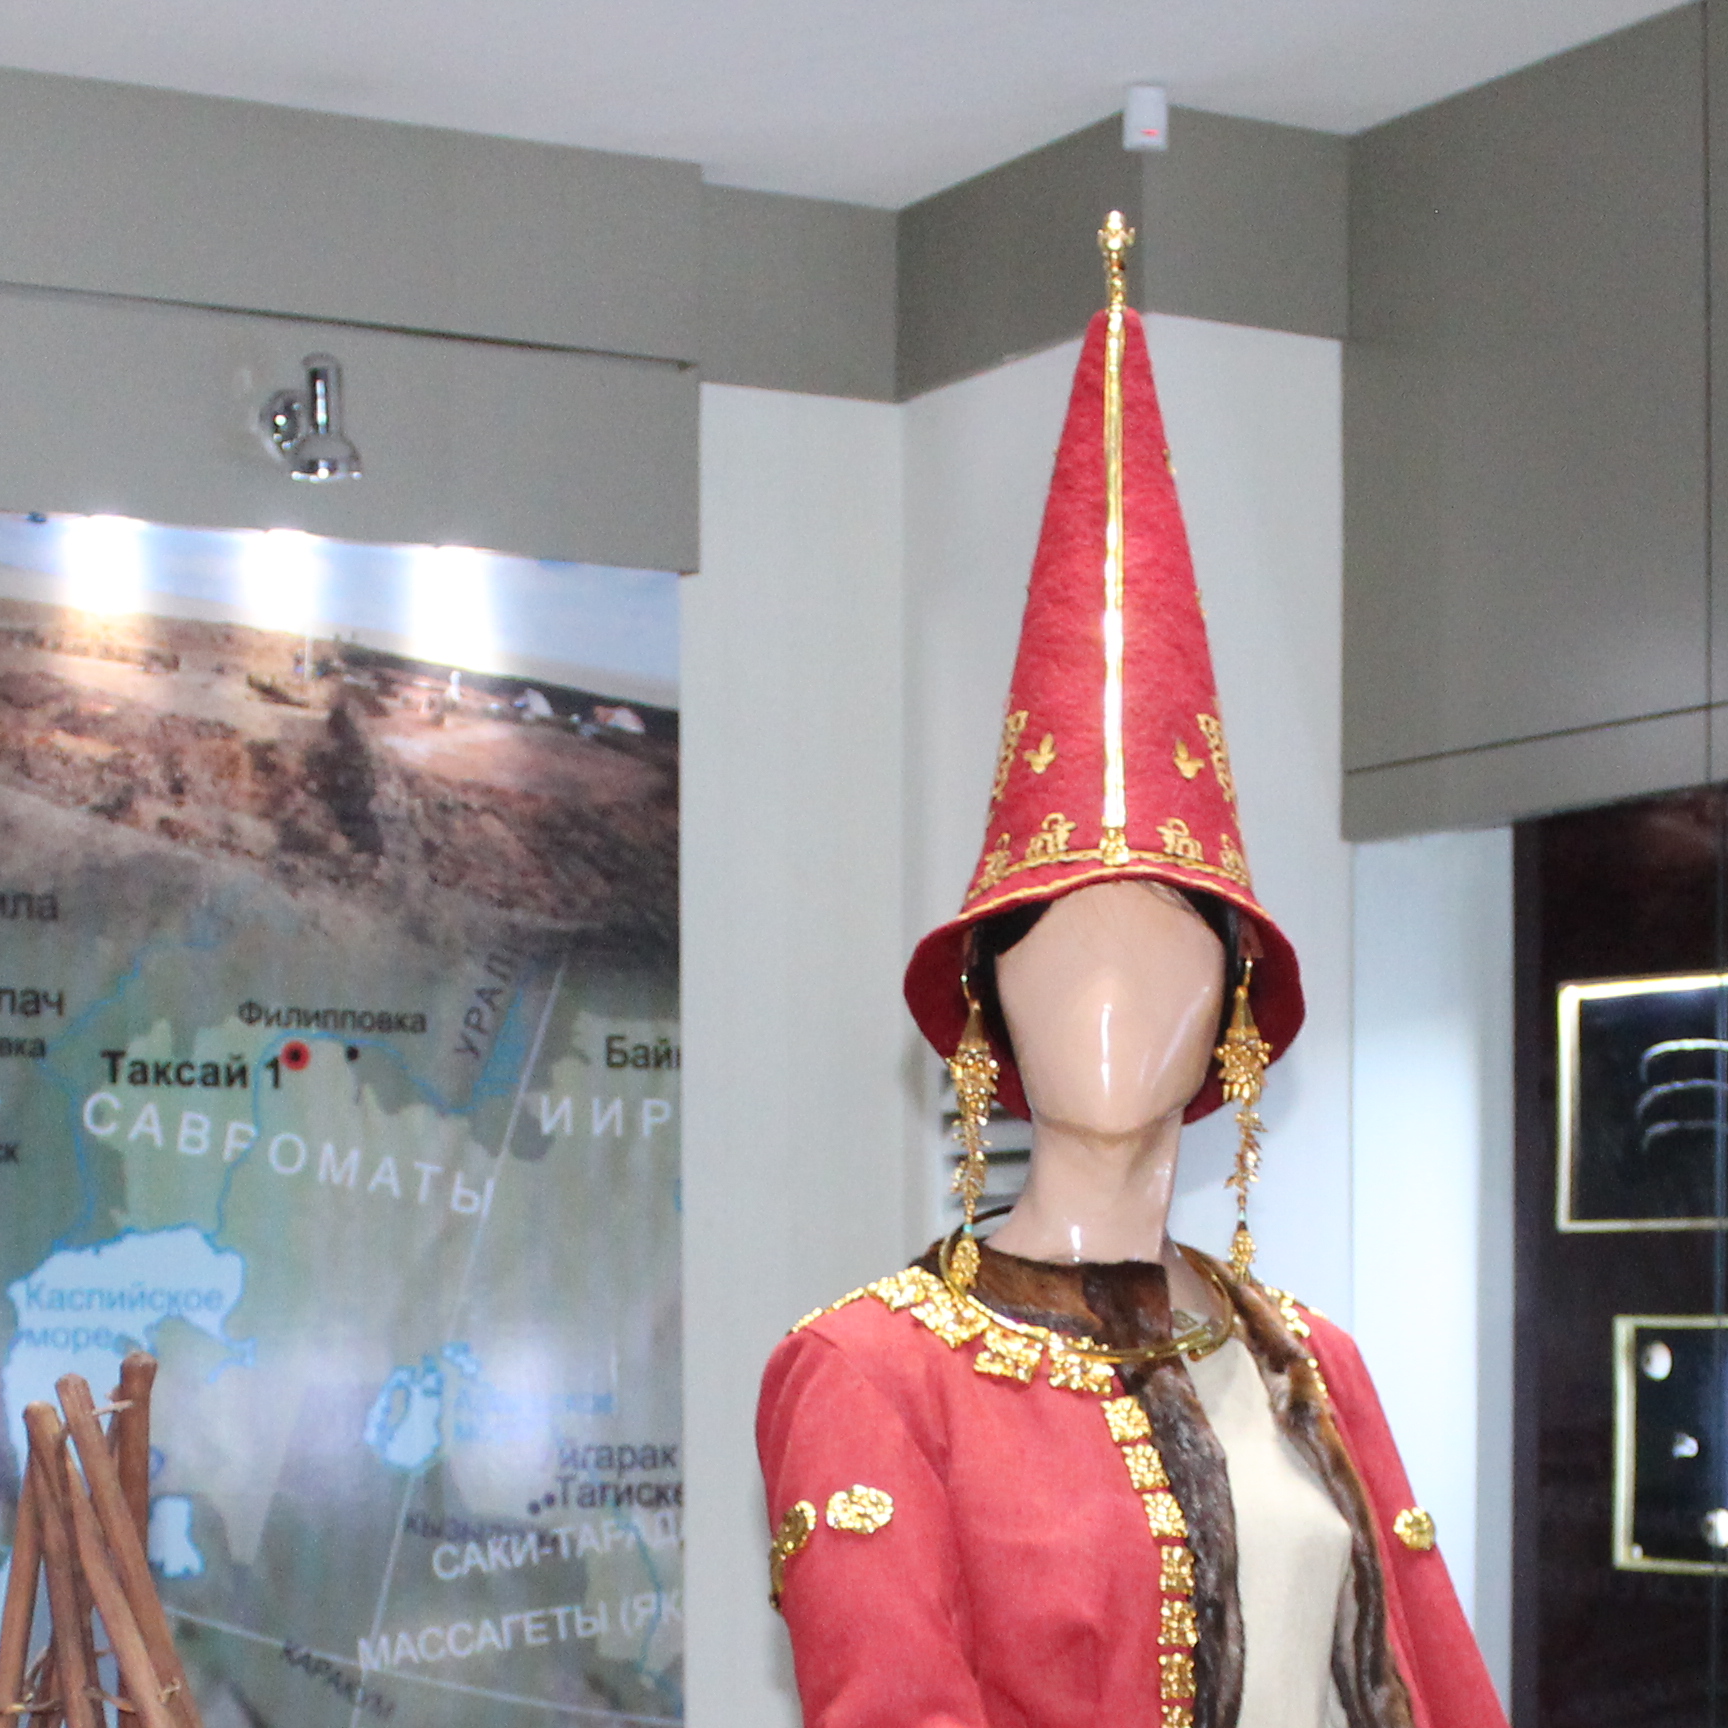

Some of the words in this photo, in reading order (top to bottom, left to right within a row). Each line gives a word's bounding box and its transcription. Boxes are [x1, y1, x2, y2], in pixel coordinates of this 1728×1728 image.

[237, 998, 428, 1034] Филипповка
[100, 1049, 248, 1089] Таксай
[264, 1055, 282, 1089] 1
[82, 1091, 496, 1218] САВРОМАТЫ
[25, 1280, 223, 1312] Каспийское
[25, 1327, 115, 1351] море
[357, 1599, 610, 1670] МАССАГЕТЫ
